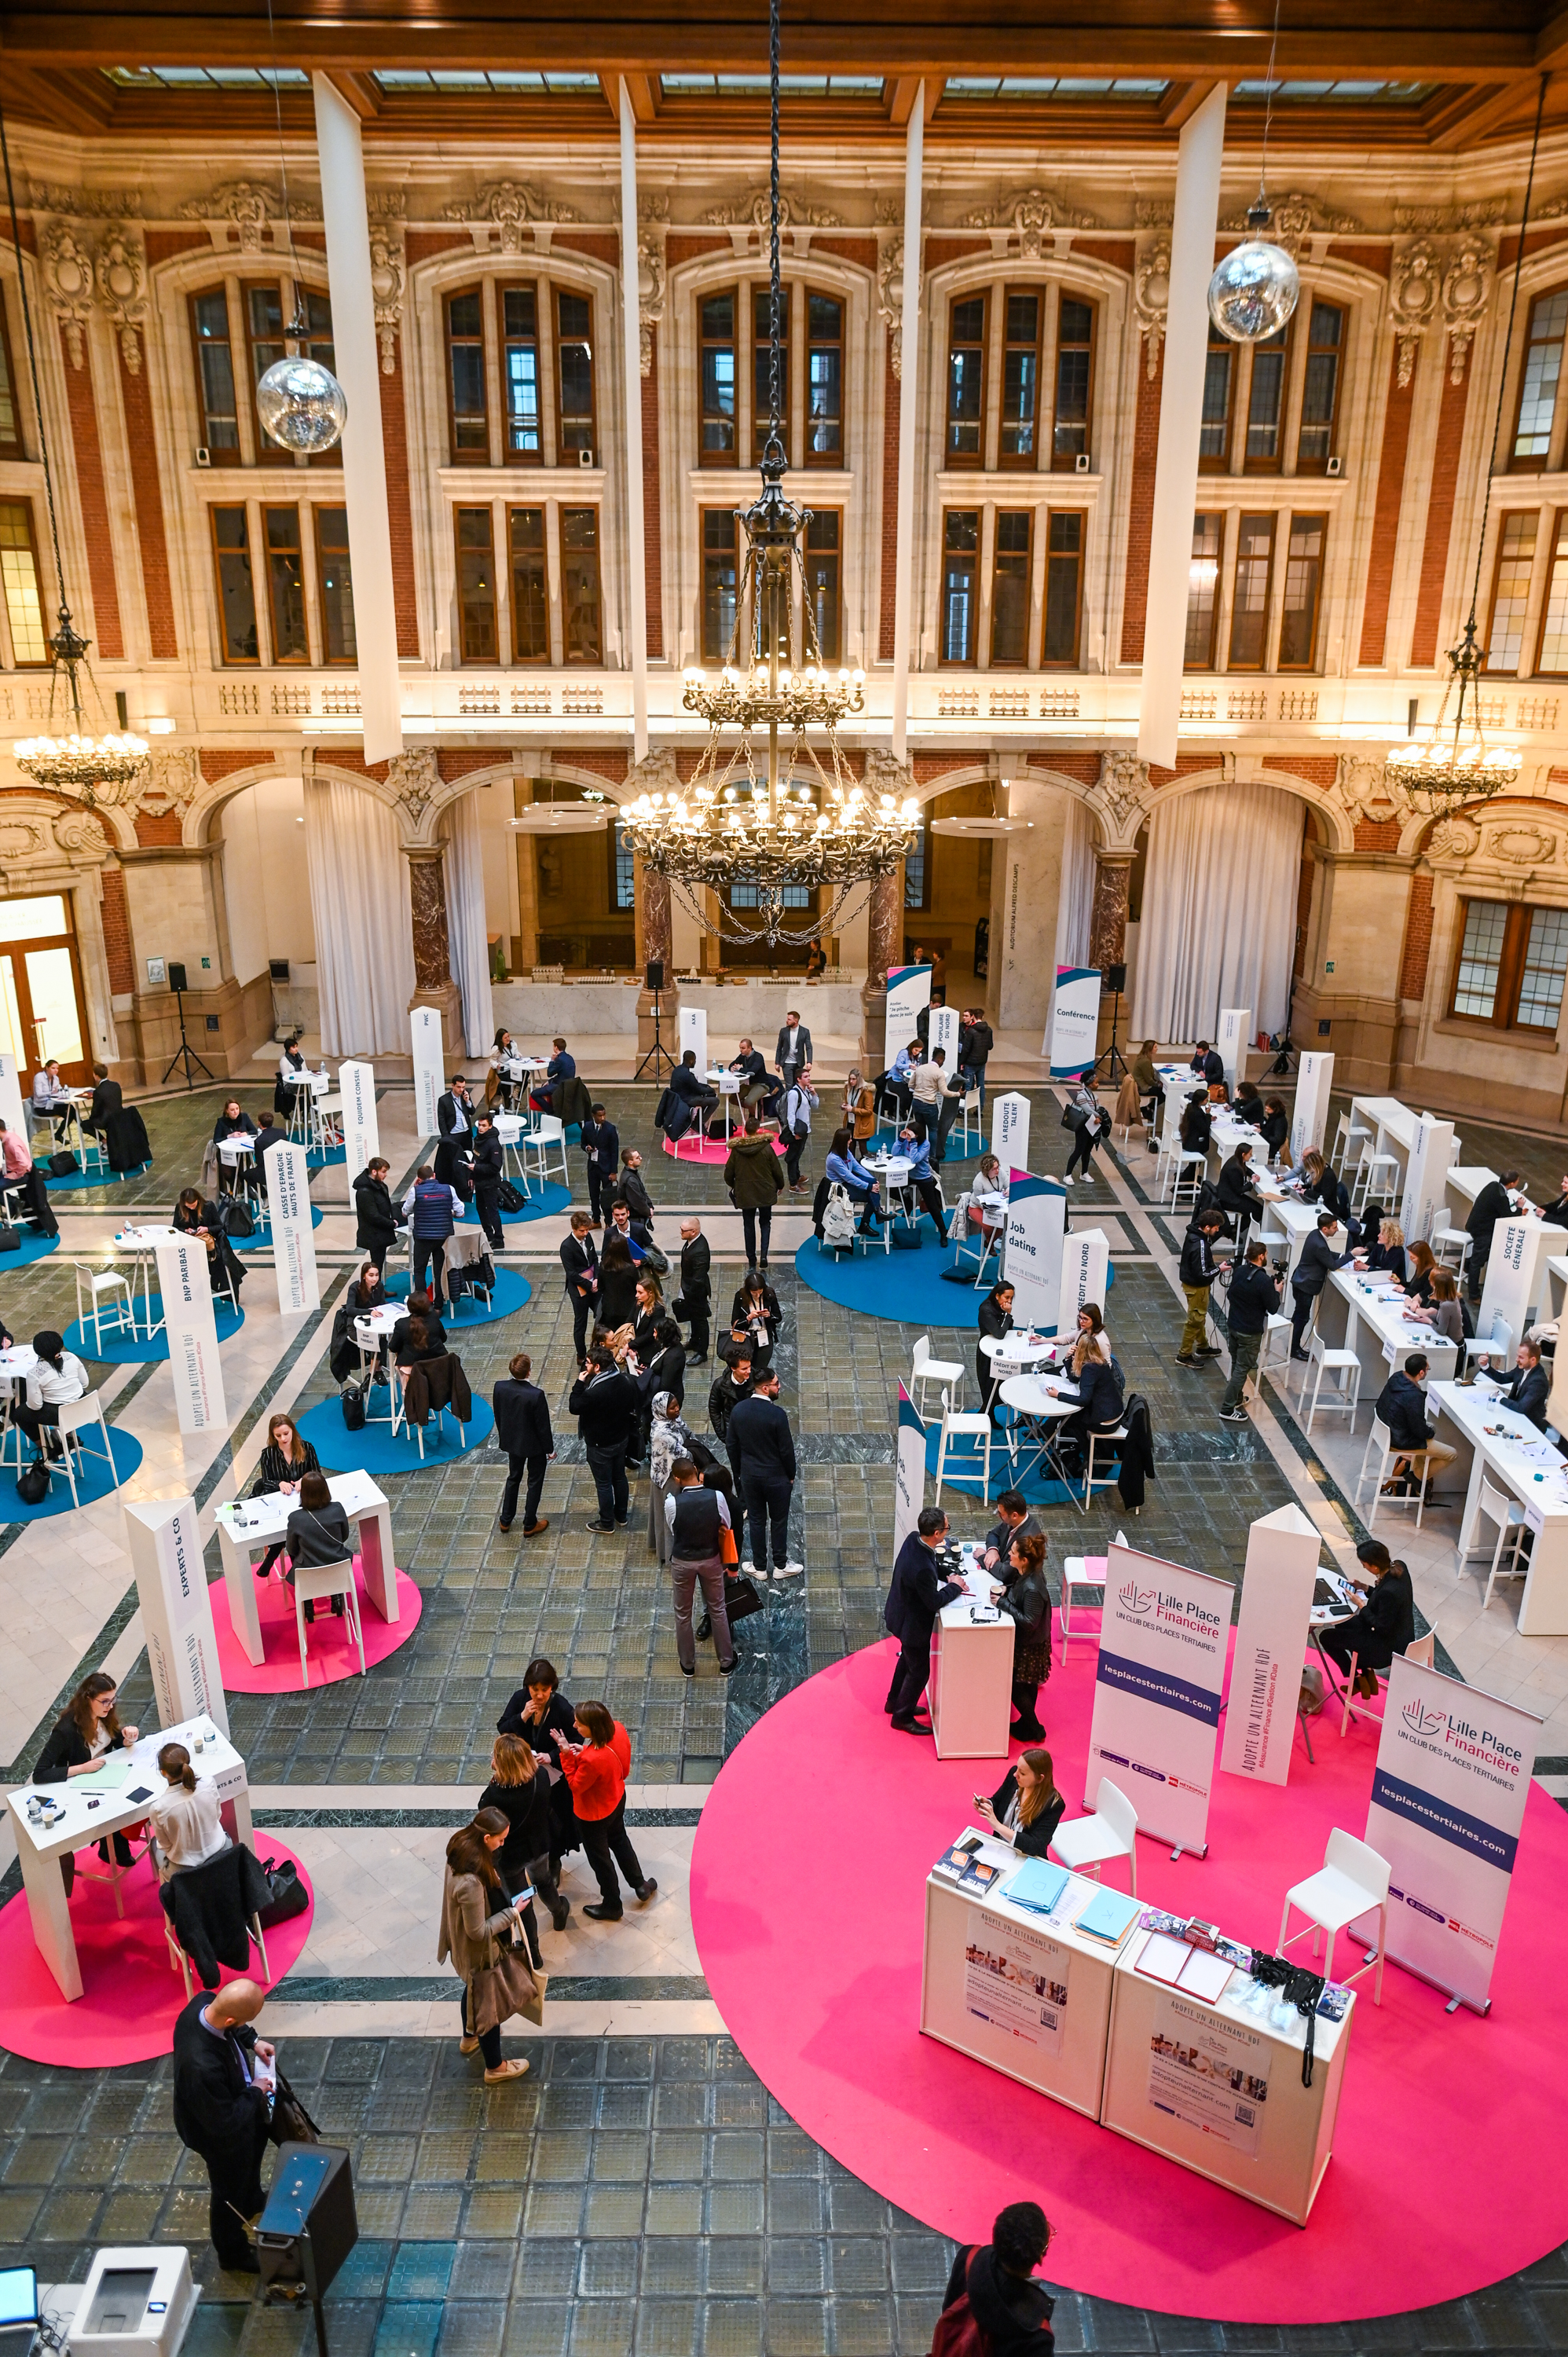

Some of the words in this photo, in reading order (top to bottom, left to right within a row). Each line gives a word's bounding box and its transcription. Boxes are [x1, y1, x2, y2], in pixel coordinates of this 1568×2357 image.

[1057, 1009, 1095, 1021] Conférence
[277, 1153, 286, 1193] D'EPARGNE
[289, 1182, 295, 1191] DE
[279, 1193, 289, 1219] CAISSE
[284, 1226, 293, 1237] HDF
[1009, 1221, 1025, 1234] Job
[287, 1240, 298, 1273] ALTERNANT
[1009, 1236, 1037, 1256] dating
[1081, 1243, 1090, 1267] NORD
[1504, 1226, 1516, 1259] SOCIÉTÉ
[1512, 1229, 1526, 1270] GÉNÉRALE
[178, 1248, 190, 1283] PARIBAS
[290, 1275, 298, 1285] UN
[1080, 1270, 1088, 1281] DU
[291, 1286, 301, 1308] ADOPTE
[183, 1333, 193, 1347] HDF
[185, 1349, 200, 1387] ALTERNANT
[192, 1389, 200, 1401] UN
[193, 1402, 205, 1427] ADOPTE
[172, 1517, 181, 1534] CO
[175, 1538, 182, 1546] &
[177, 1548, 190, 1598] EXPERTS
[1156, 1605, 1219, 1639] Financière
[1158, 1592, 1183, 1611] Lille
[1186, 1602, 1221, 1626] Place
[185, 1633, 196, 1654] HDF
[1126, 1615, 1142, 1626] CLUB
[1143, 1621, 1156, 1631] DES
[1156, 1626, 1180, 1639] PLACES
[1181, 1634, 1216, 1653] TERTIAIRES
[1255, 1648, 1270, 1666] HDF
[189, 1653, 205, 1706] ALTERNANT
[1105, 1664, 1212, 1712] lesplacestertiaires.com
[1250, 1669, 1268, 1719] ALTERNANT
[1266, 1682, 1276, 1708] #Gestion
[198, 1706, 206, 1717] N
[1262, 1709, 1273, 1735] #Finance
[1247, 1722, 1261, 1736] UN
[1448, 1715, 1478, 1740] Lille
[1482, 1730, 1522, 1761] Place
[1242, 1739, 1259, 1772] ADOPTE
[1258, 1736, 1269, 1769] #Assurance
[1398, 1729, 1409, 1740] UN
[1409, 1735, 1428, 1749] CLUB
[1429, 1744, 1443, 1756] DES
[1444, 1751, 1472, 1771] PLACES
[1473, 1765, 1515, 1792] TERTIAIRES
[1445, 1729, 1520, 1776] Financière
[1179, 1781, 1207, 1797] MÉTROPOLE
[1381, 1785, 1506, 1856] lesplacestertiaires.com
[981, 1913, 1001, 1926] ADOPTE
[1003, 1923, 1012, 1933] UN
[1013, 1929, 1046, 1948] ALTERNANT
[1048, 1942, 1059, 1954] HDF
[1460, 1927, 1494, 1948] MÉTROPOLE
[967, 1978, 1036, 2014] adopteunalternant.com
[1171, 2000, 1193, 2017] ADOPTE
[1196, 2012, 1206, 2022] UN
[1208, 2018, 1245, 2040] ALTERNANT
[1247, 2035, 1260, 2046] HDF
[1152, 2069, 1230, 2110] adopteunalternant.com
